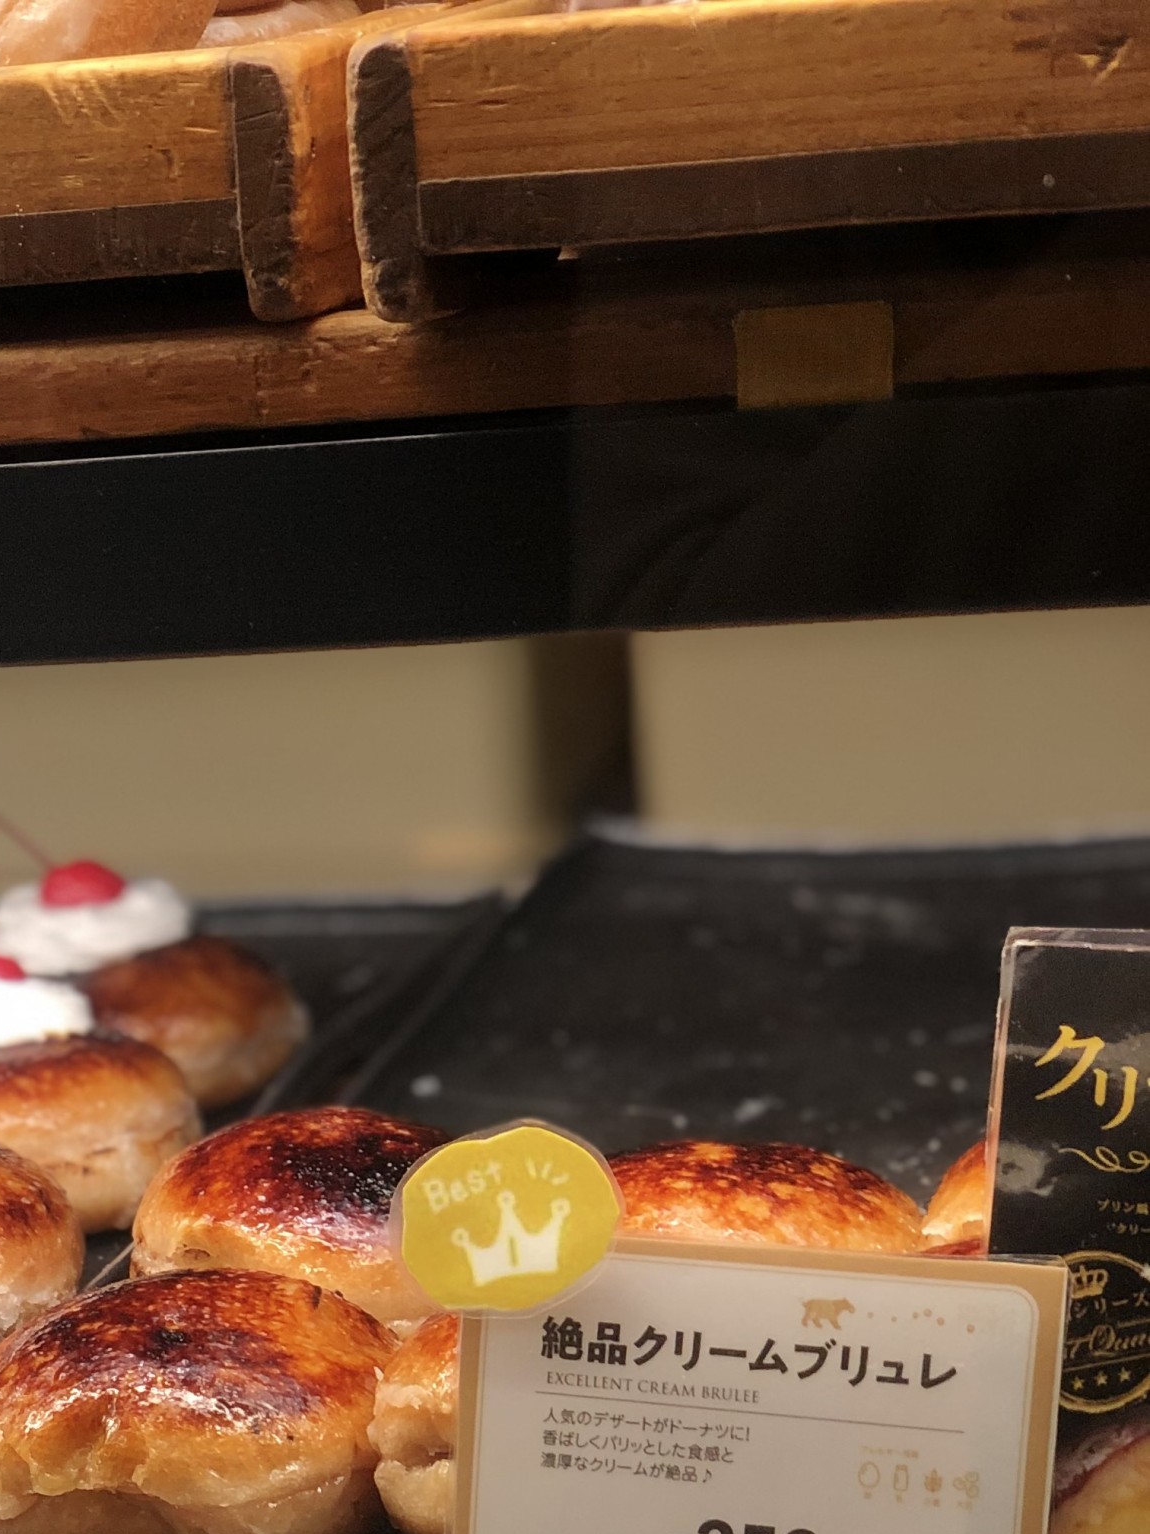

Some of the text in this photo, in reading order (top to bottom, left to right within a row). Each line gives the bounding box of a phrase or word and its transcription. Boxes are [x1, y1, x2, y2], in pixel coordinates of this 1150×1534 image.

[1034, 1024, 1150, 1131] クリ
[541, 1315, 957, 1389] 絶品クリームブリュレ
[547, 1371, 760, 1404] EXCELLENT CREAM BRULEE
